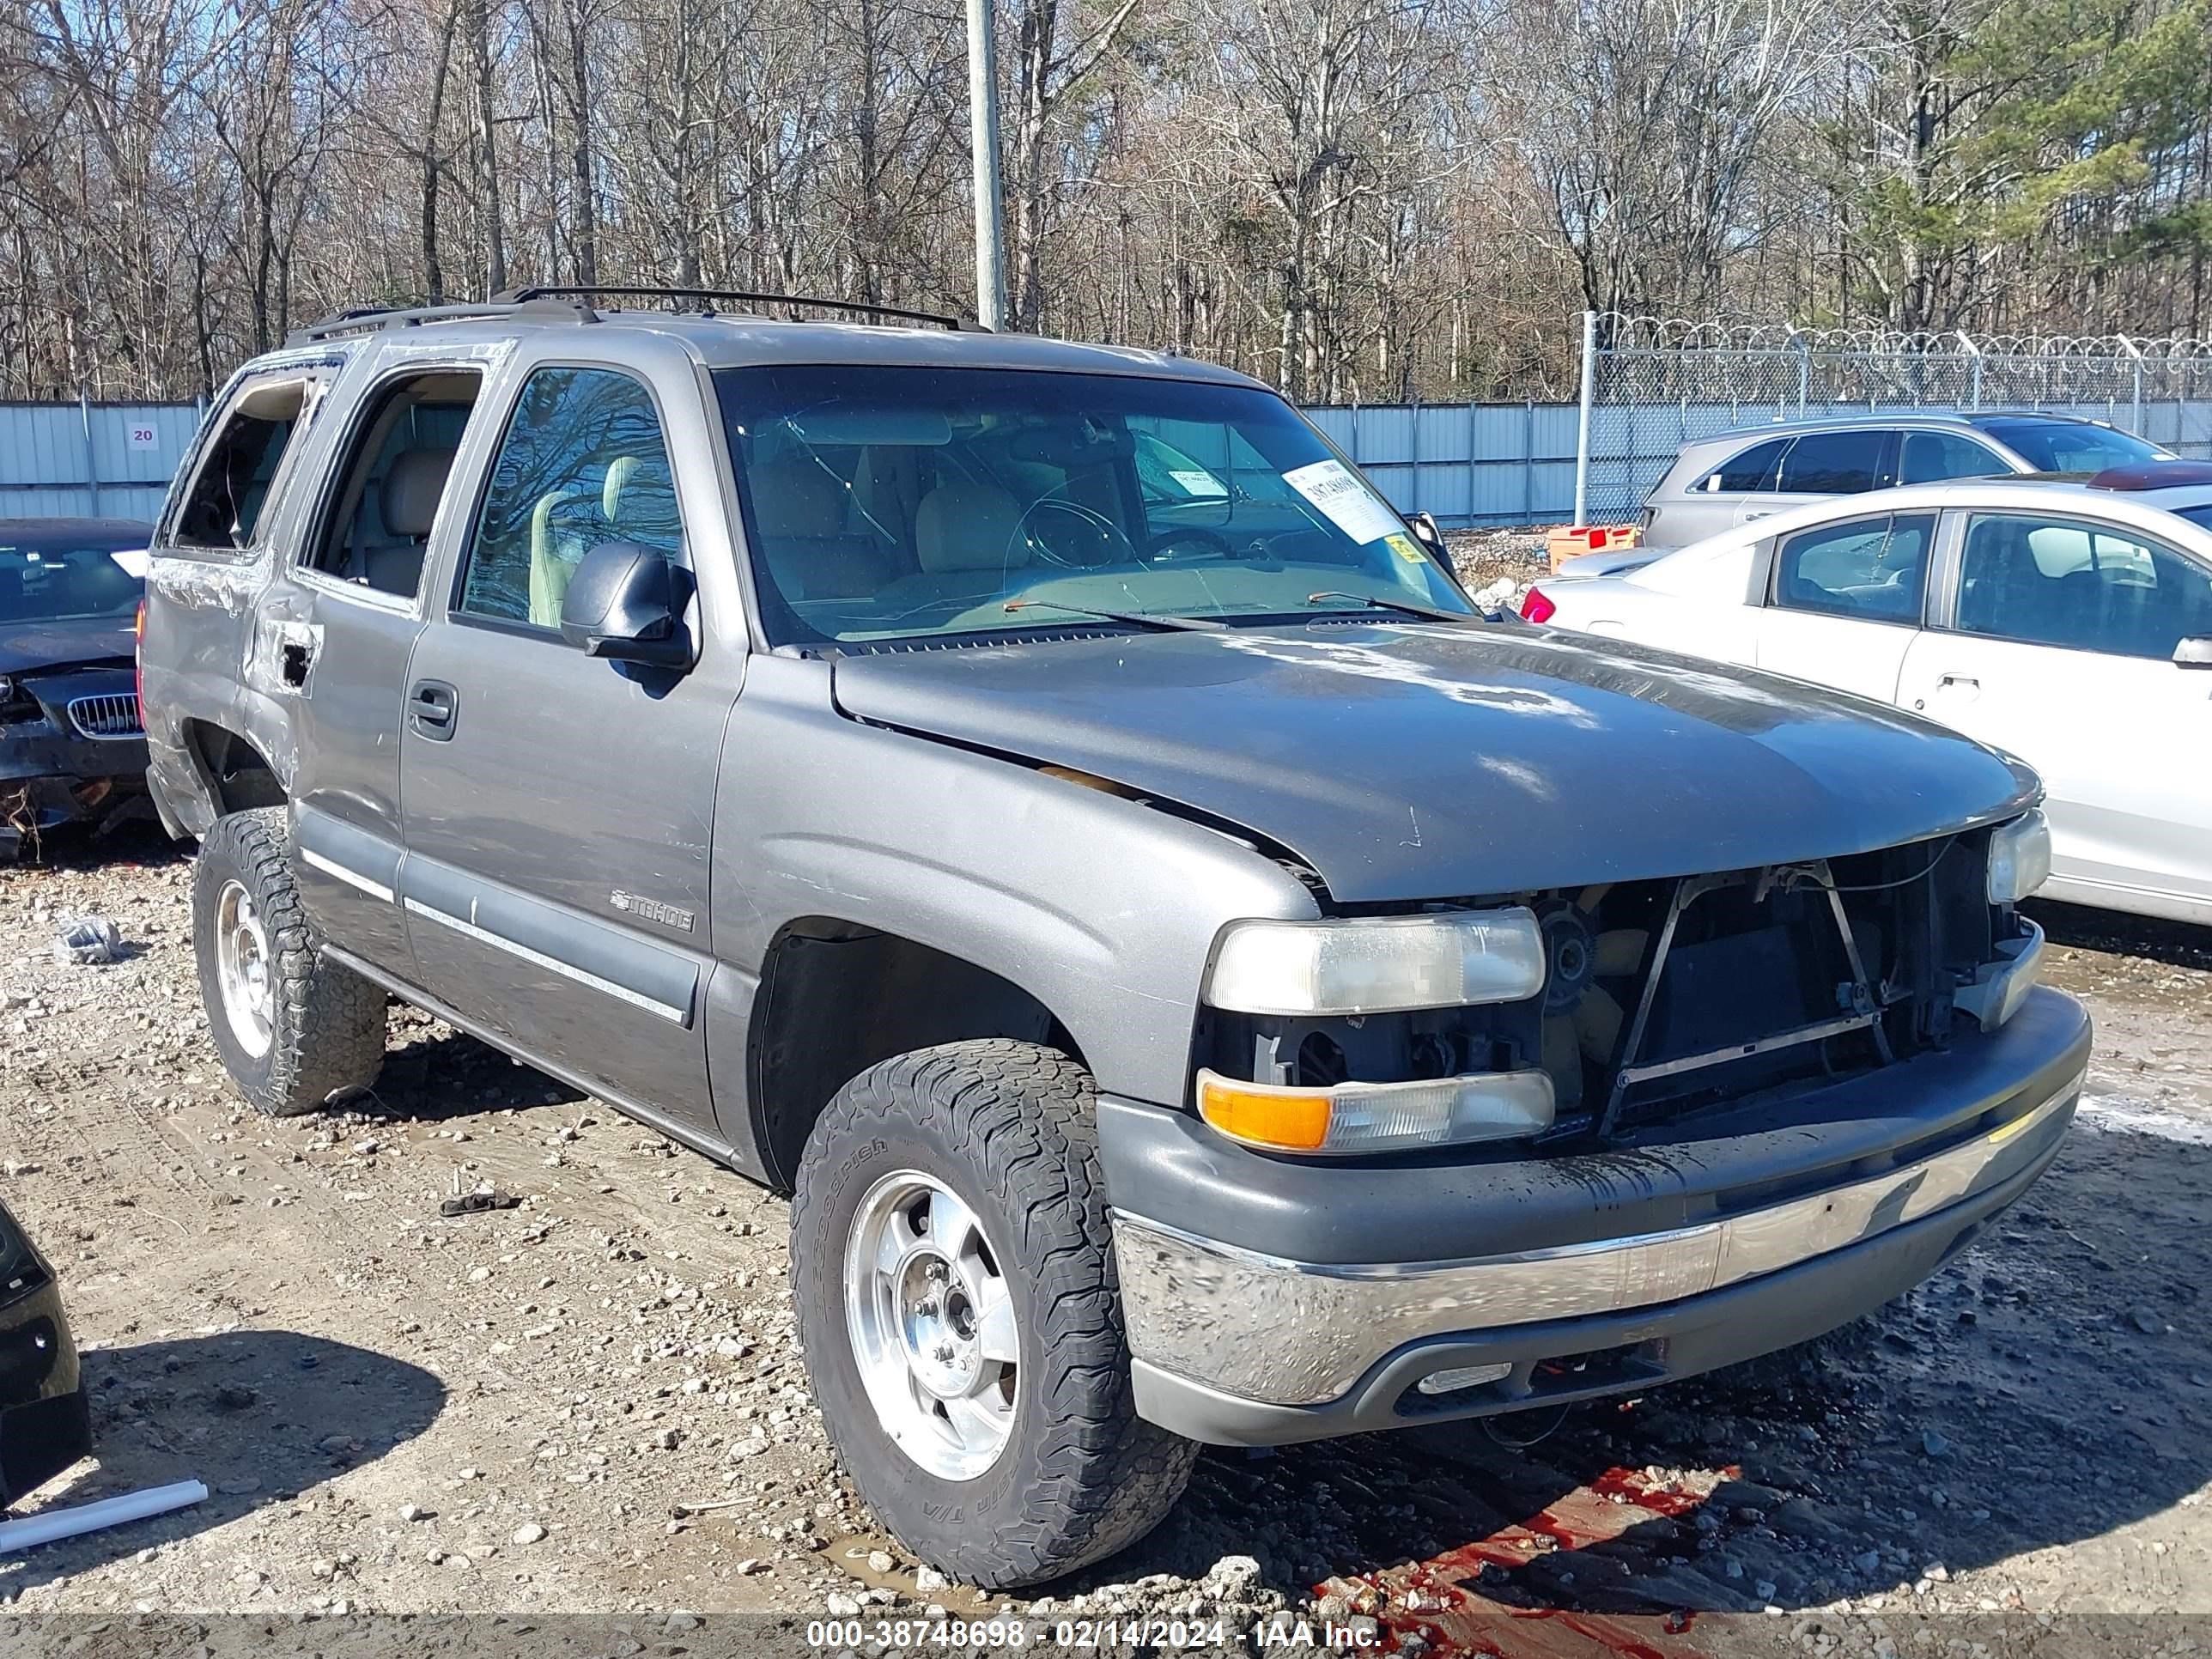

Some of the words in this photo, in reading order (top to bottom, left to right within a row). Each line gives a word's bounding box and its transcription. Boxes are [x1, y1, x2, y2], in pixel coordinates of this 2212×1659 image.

[134, 430, 153, 441] 20
[1307, 476, 1359, 501] 38748698
[628, 895, 696, 933] TAHOE
